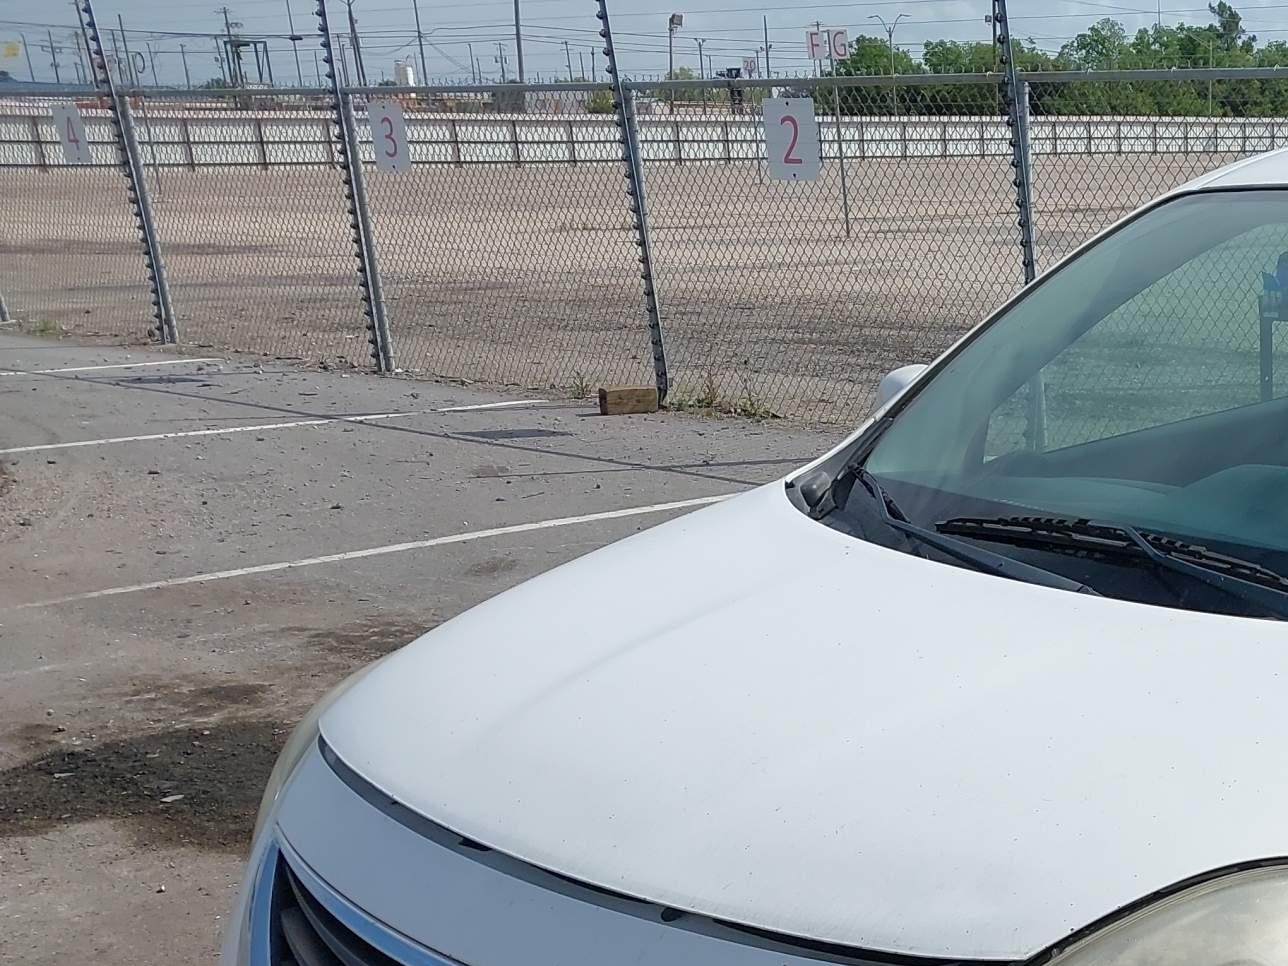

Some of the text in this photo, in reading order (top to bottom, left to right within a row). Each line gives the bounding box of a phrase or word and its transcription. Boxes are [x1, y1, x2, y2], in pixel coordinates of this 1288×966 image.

[809, 32, 821, 58] F
[832, 31, 847, 57] G
[66, 115, 81, 151] 4
[380, 116, 398, 158] 3
[780, 114, 803, 165] 2
